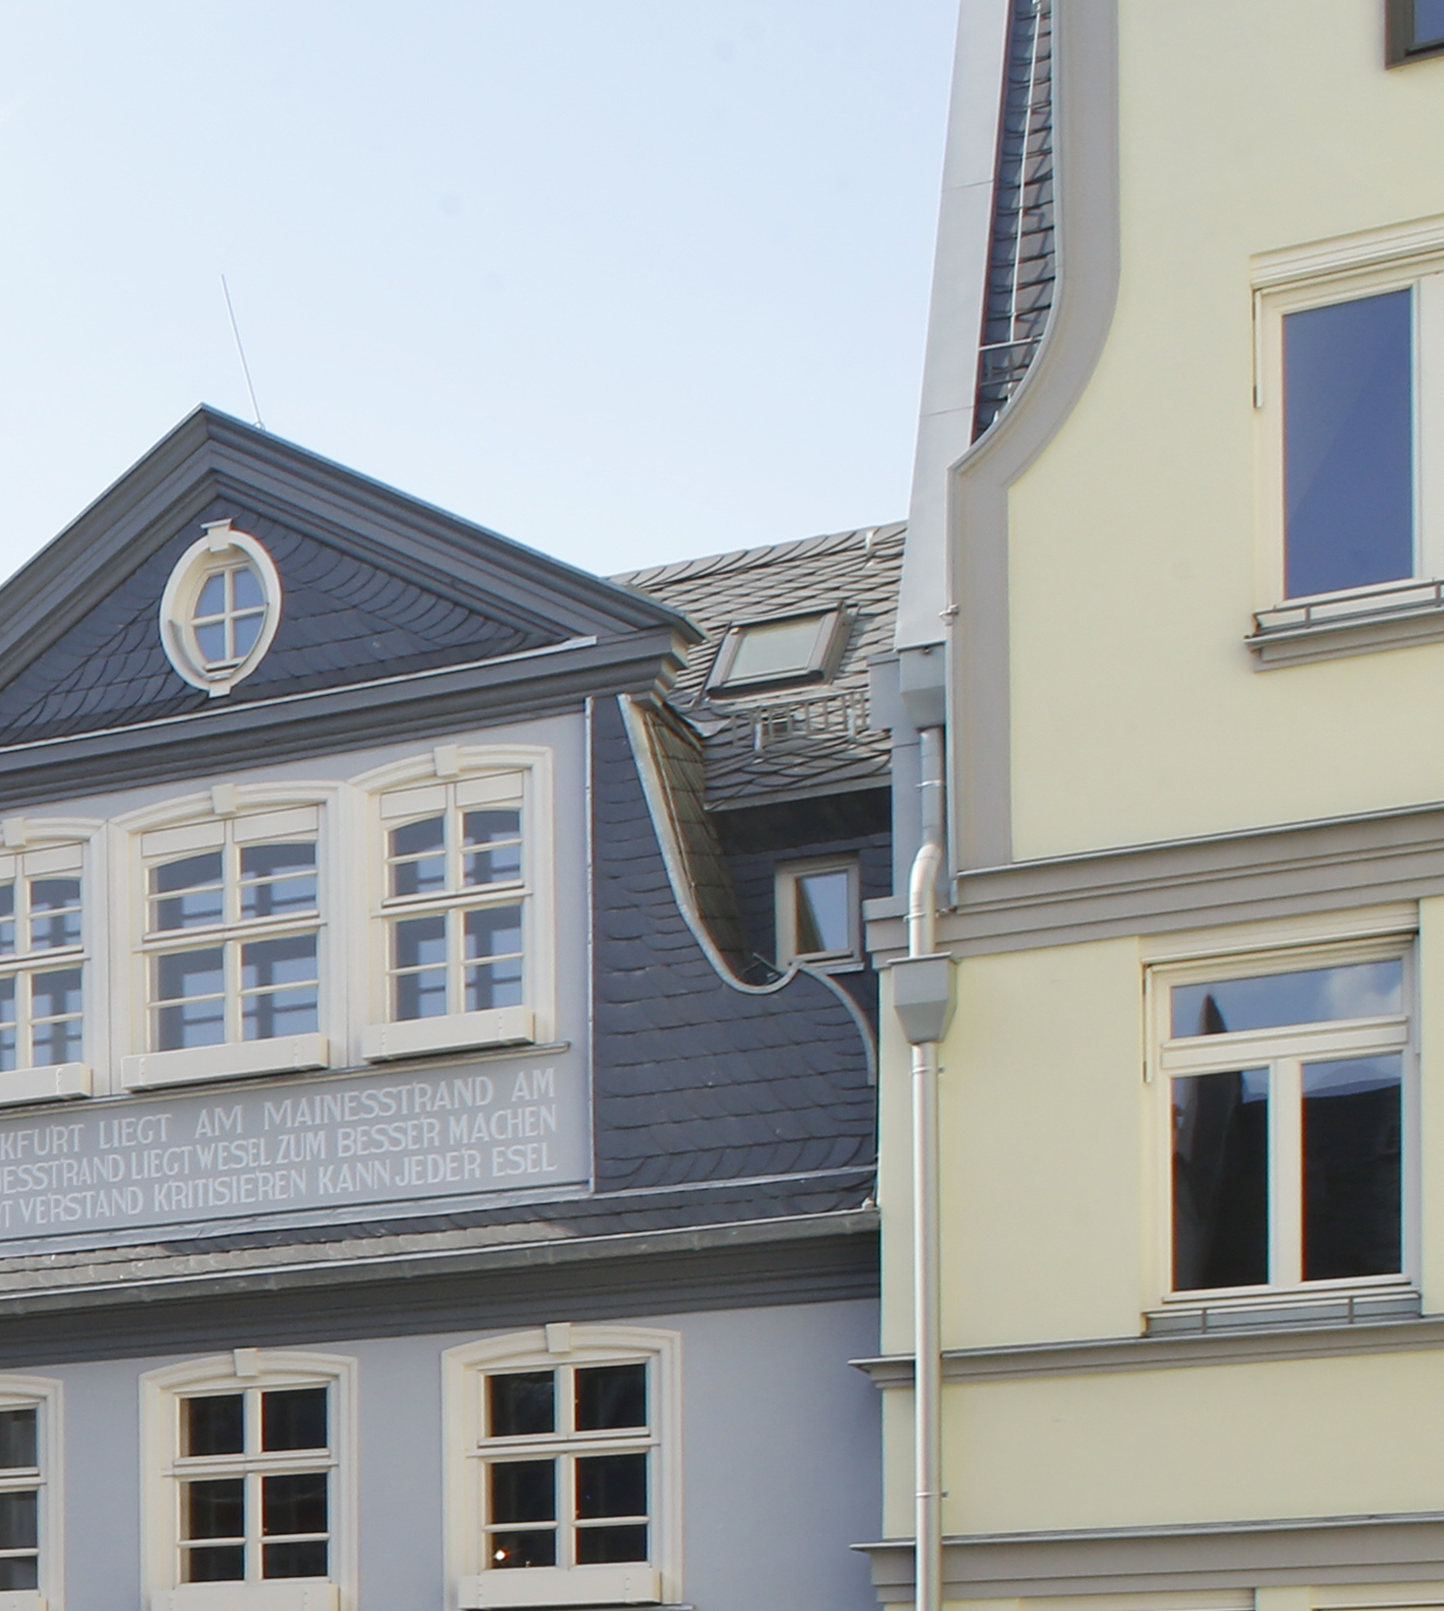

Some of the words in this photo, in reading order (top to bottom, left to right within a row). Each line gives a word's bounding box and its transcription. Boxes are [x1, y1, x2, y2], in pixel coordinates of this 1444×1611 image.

[99, 1114, 172, 1149] LIEGT
[195, 1105, 243, 1139] AM
[264, 1076, 494, 1131] MAINESSTRAND
[510, 1067, 556, 1102] AM
[131, 1146, 192, 1180] LIEGT
[195, 1139, 270, 1171] WESEL
[276, 1129, 326, 1165] ZUM
[337, 1116, 439, 1158] BESSER
[449, 1104, 556, 1144] MACHEN
[18, 1186, 143, 1224] VERSTAND
[154, 1168, 307, 1212] KRITISIEREN
[318, 1160, 390, 1194] KANN
[395, 1148, 480, 1187] JEDER
[492, 1143, 556, 1177] ESEL
